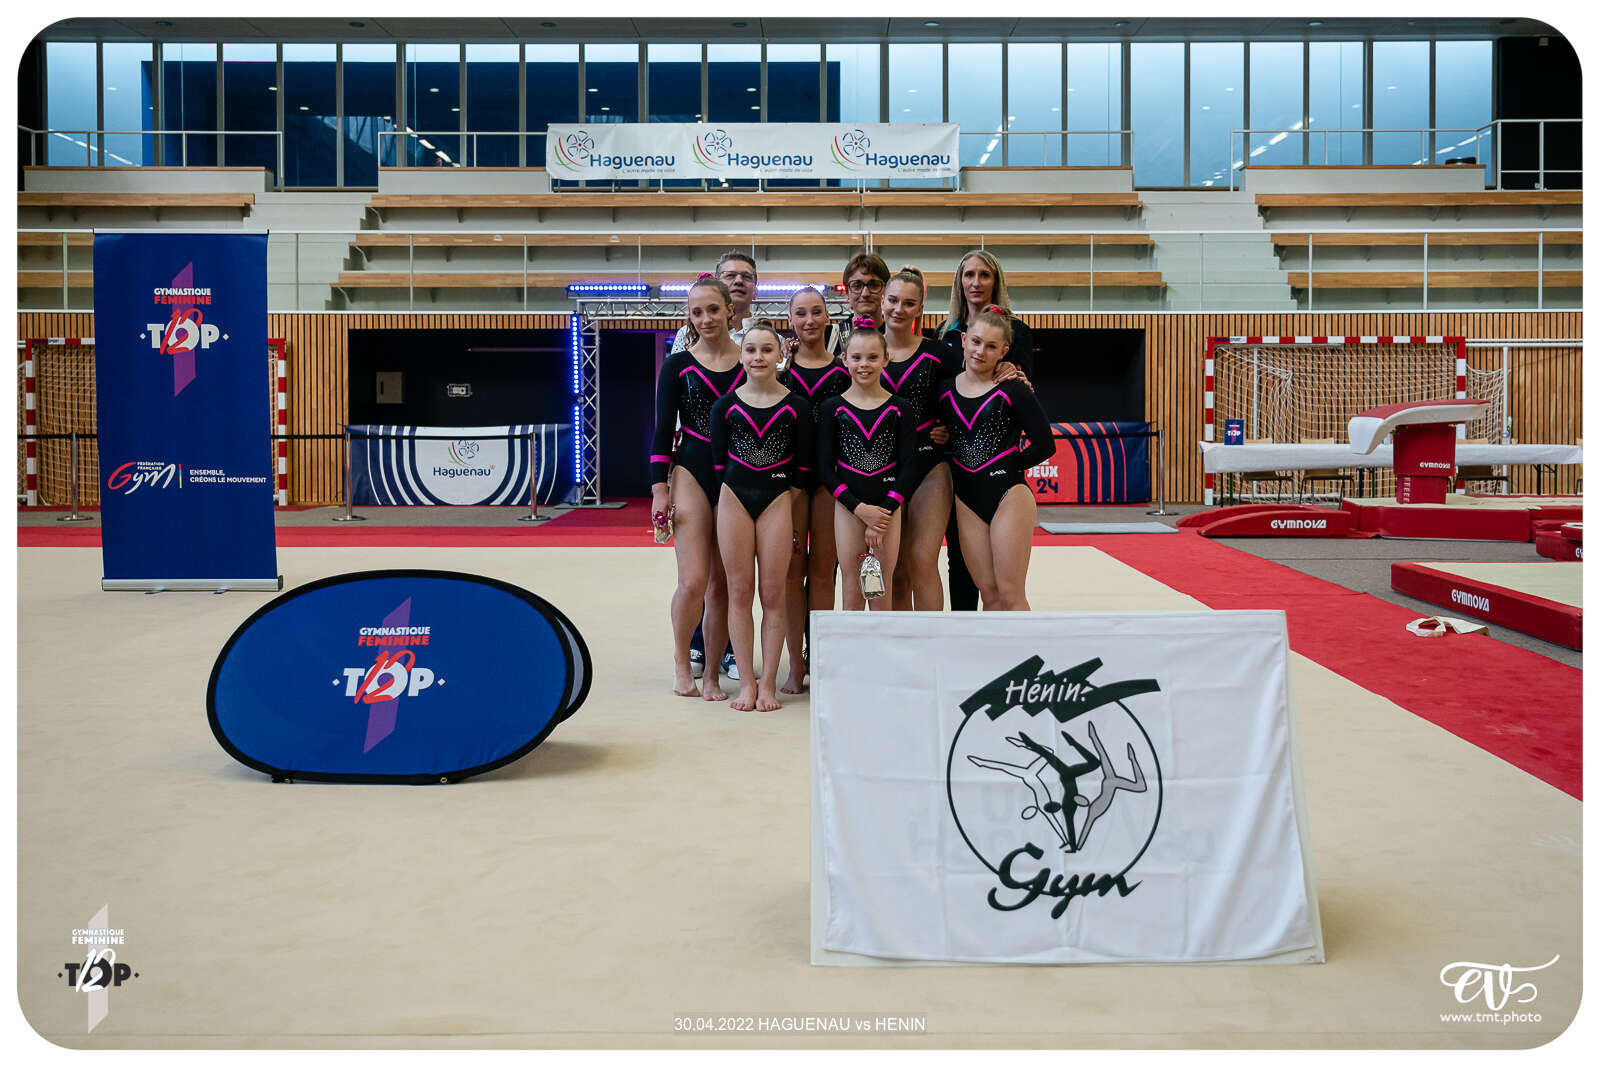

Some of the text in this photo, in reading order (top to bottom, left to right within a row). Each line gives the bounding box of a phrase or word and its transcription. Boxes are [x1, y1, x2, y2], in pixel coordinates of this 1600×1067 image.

[590, 154, 675, 169] Haguenau
[728, 153, 813, 169] Haguenau
[865, 153, 950, 168] Haguenau
[147, 317, 220, 350] TOP
[433, 467, 491, 478] Haguenau
[1027, 465, 1059, 477] JEUX
[1420, 461, 1451, 469] GYMNOVA
[1037, 479, 1058, 493] 24
[1271, 520, 1327, 528] GYMNOVA
[1451, 589, 1490, 612] GYMNOVA
[360, 627, 431, 635] GYMNASTIQUE
[343, 660, 435, 700] TOP
[987, 843, 1143, 919] Gym
